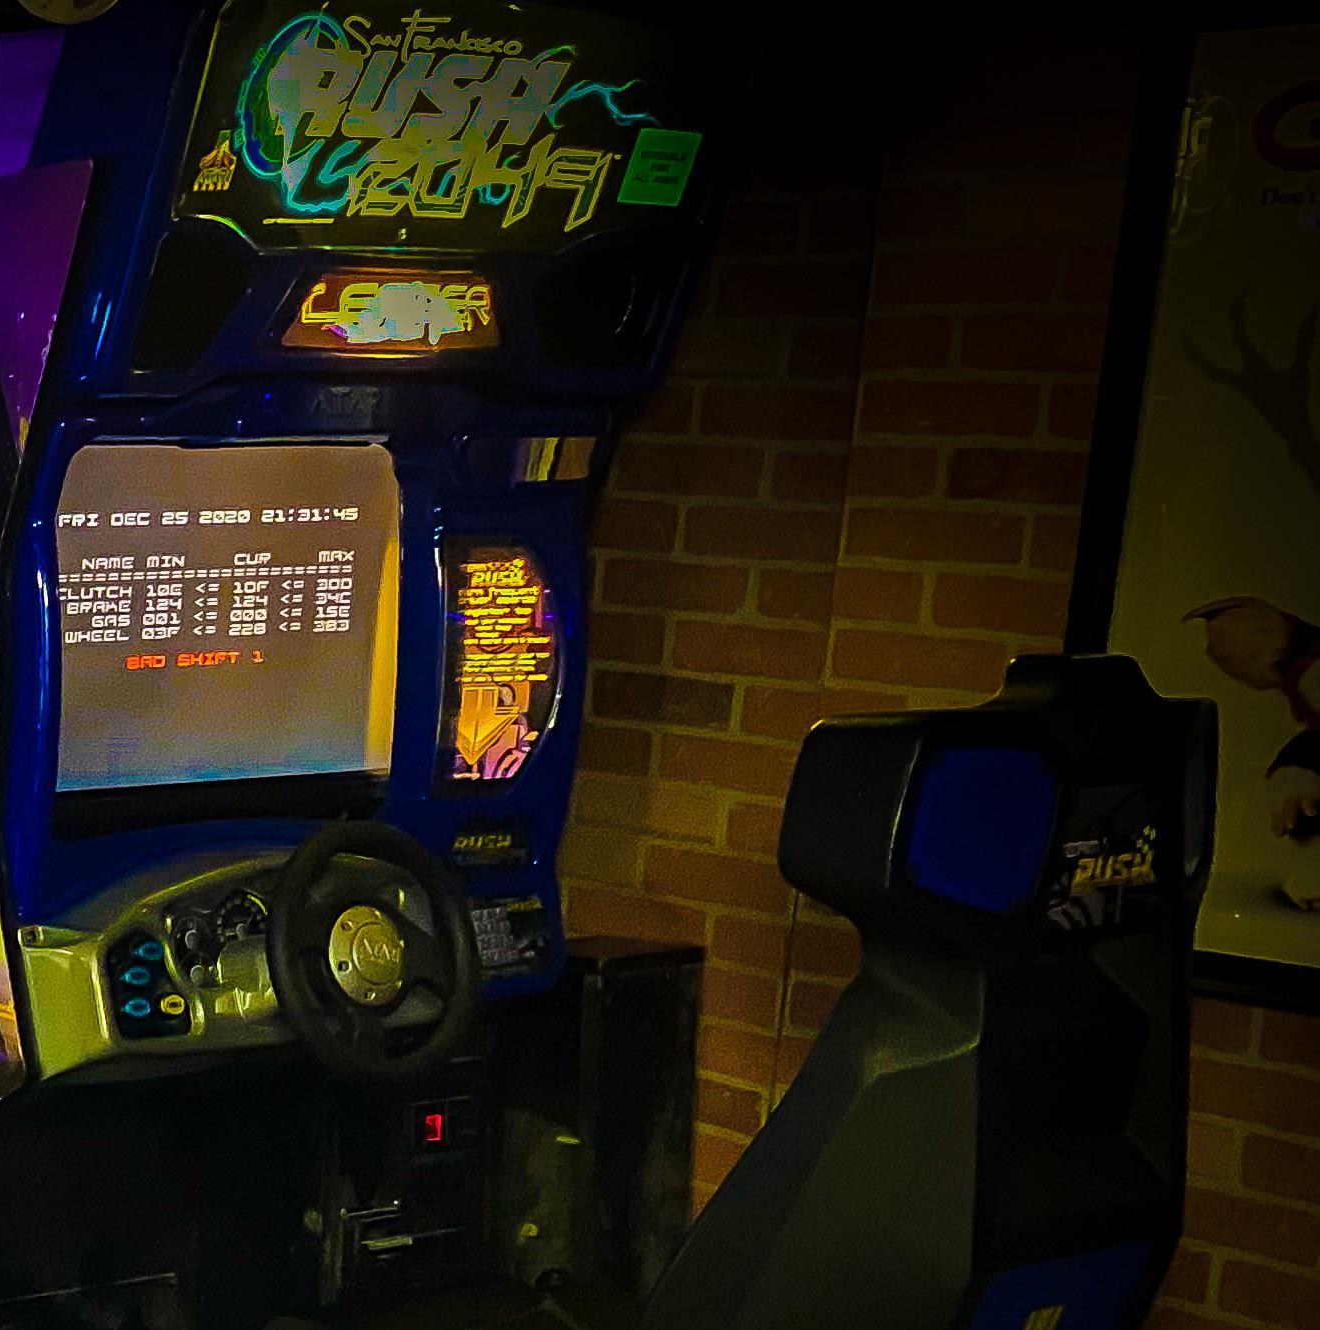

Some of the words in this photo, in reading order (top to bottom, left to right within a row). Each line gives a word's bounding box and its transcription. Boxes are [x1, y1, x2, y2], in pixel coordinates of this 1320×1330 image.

[268, 35, 571, 146] RUSH
[58, 513, 100, 528] FRI
[110, 511, 151, 527] DEC
[161, 511, 189, 526] 25
[198, 509, 251, 525] 2020
[261, 507, 359, 523] 21:31:45
[81, 556, 135, 570] NAME
[146, 555, 186, 568] MIN
[233, 552, 272, 566] CUR
[318, 550, 355, 563] MAX
[58, 585, 133, 600] CLUTCH
[66, 600, 132, 615] BRAKE
[145, 598, 183, 612] 124
[231, 594, 269, 608] 124
[91, 614, 131, 628] GAS
[142, 612, 182, 626] 001
[229, 608, 268, 622] 000
[64, 629, 131, 644] WHEEL
[141, 626, 182, 640] 03F
[124, 654, 167, 670] BAD
[176, 650, 240, 667] SHIFT
[252, 650, 264, 663] 1
